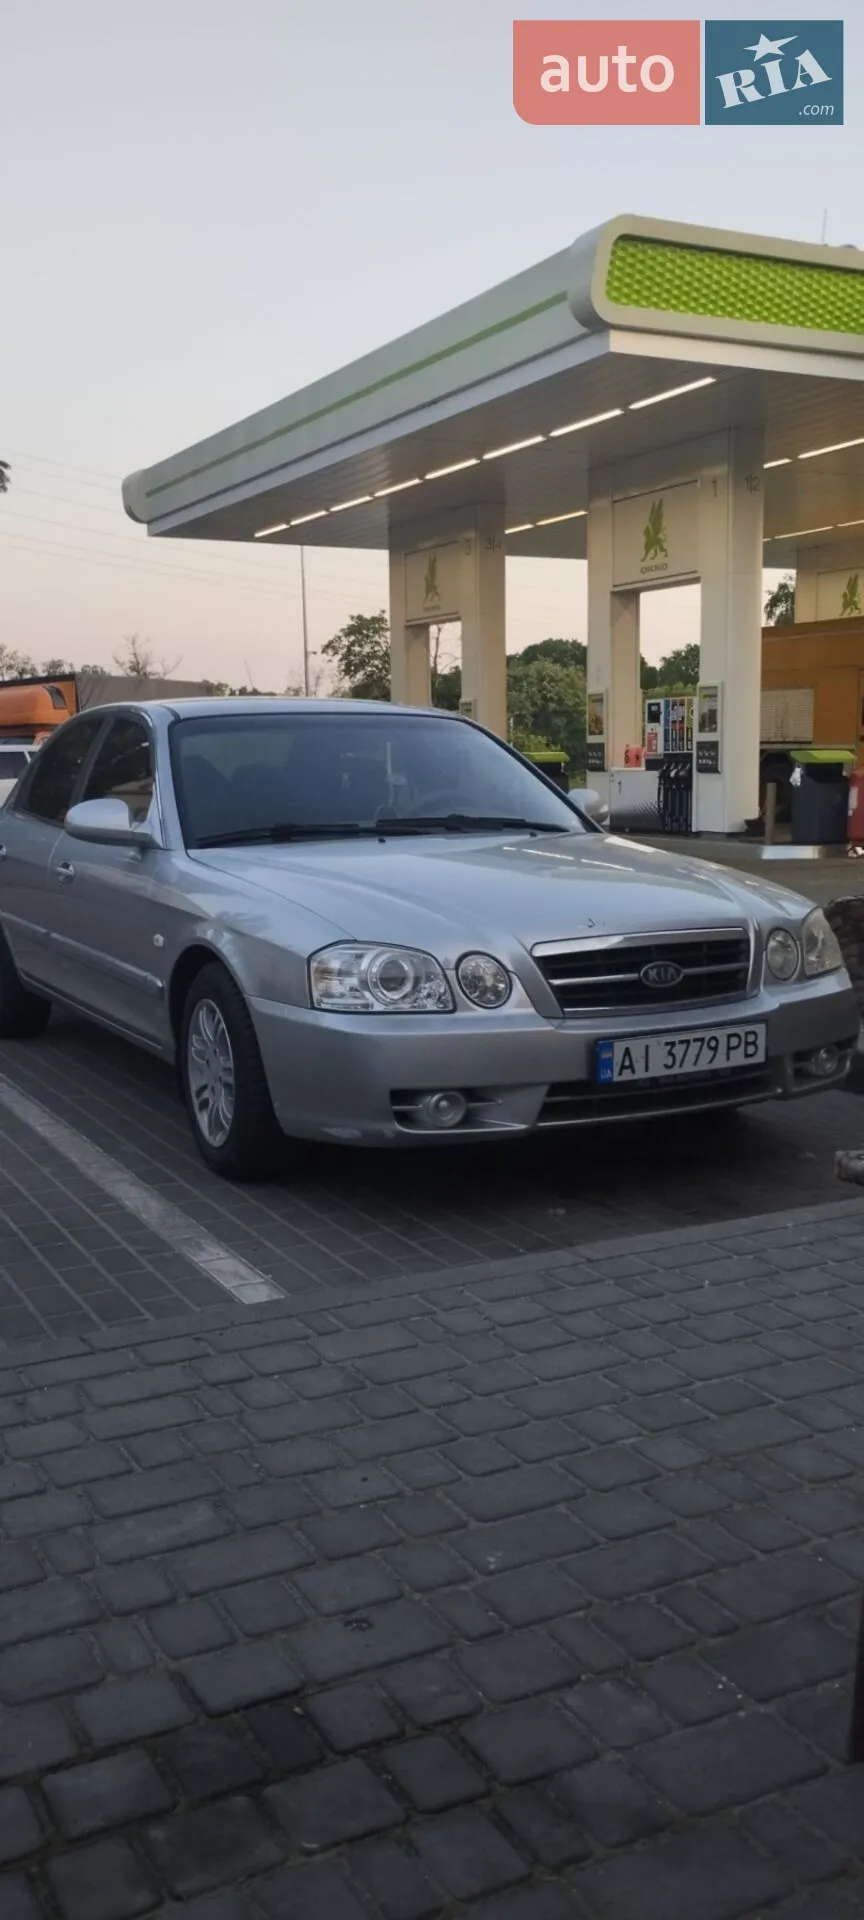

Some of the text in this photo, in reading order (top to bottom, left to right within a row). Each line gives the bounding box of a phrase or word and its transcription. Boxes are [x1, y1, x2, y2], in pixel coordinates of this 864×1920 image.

[648, 967, 678, 981] KIA
[618, 1030, 759, 1077] AI 3779 PB
